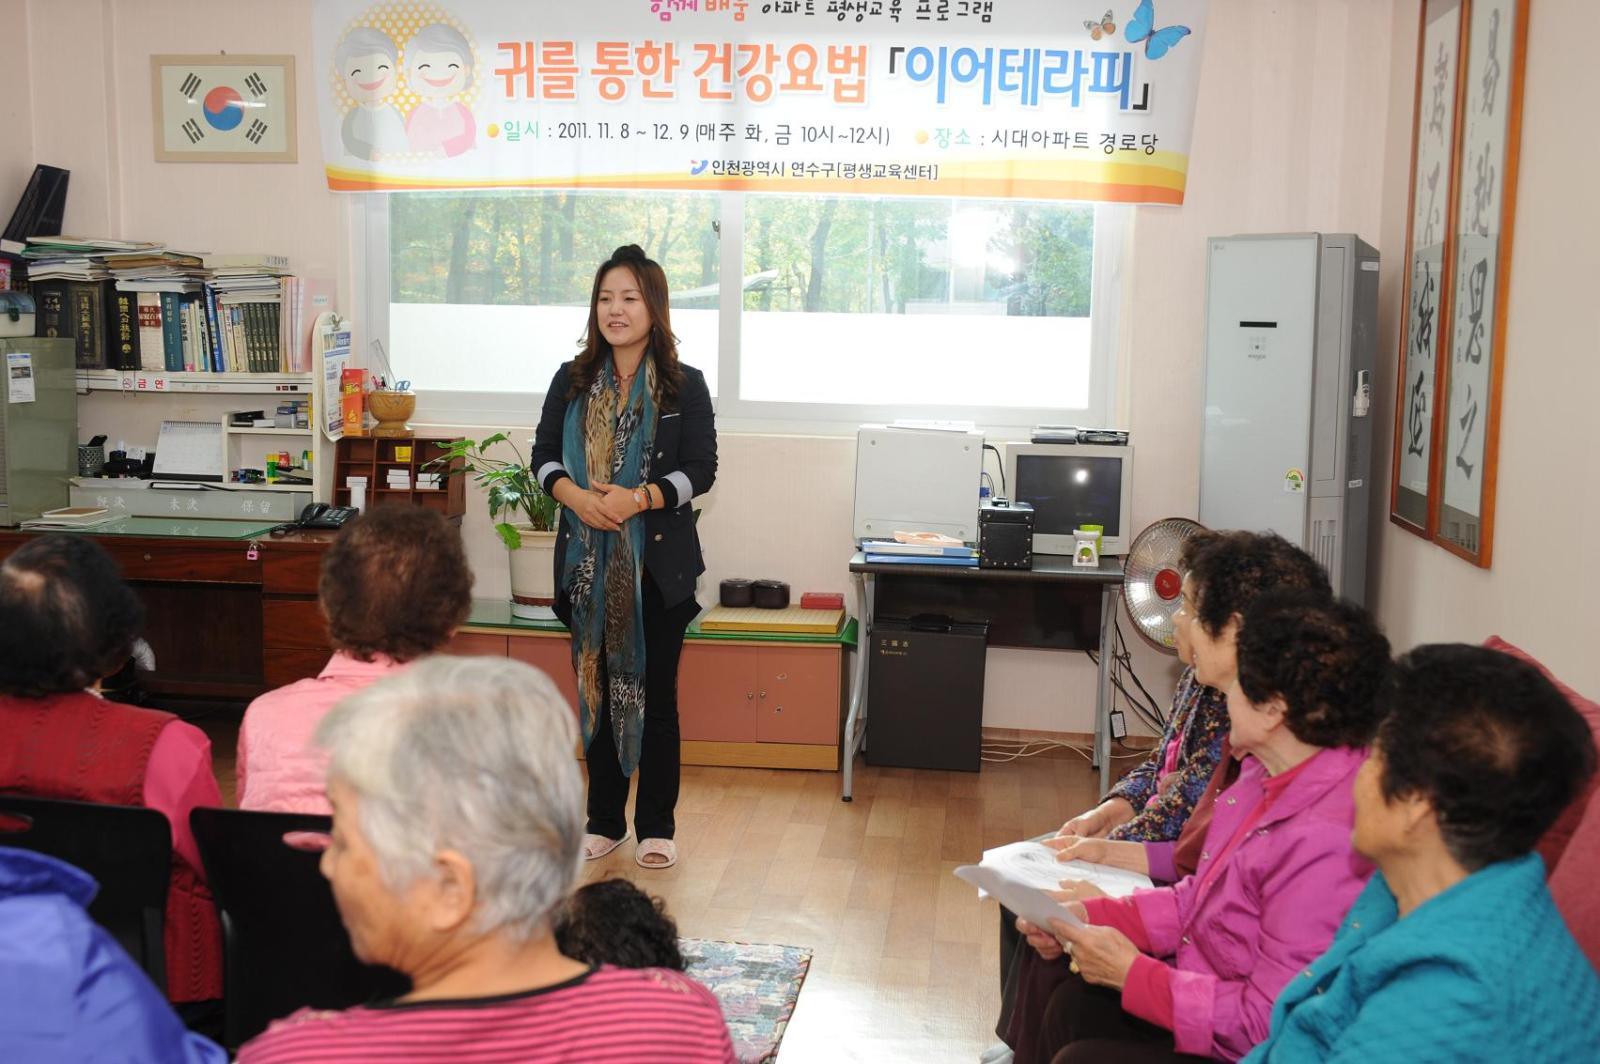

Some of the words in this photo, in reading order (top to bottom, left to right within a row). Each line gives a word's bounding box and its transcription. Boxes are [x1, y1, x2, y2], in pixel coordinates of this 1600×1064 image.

[762, 0, 815, 16] 아파트
[827, 0, 902, 23] 평생교육
[916, 0, 993, 23] 프로그램
[494, 40, 579, 99] 귀를
[591, 40, 680, 100] 통한
[693, 42, 867, 102] 건강요법
[504, 121, 540, 142] 일시
[558, 122, 591, 139] 2011.
[597, 122, 614, 139] 11.
[620, 122, 630, 140] 8
[652, 123, 673, 140] 12.
[679, 123, 690, 140] 9
[695, 122, 737, 143] (매주
[744, 123, 769, 144] 화,
[774, 124, 792, 145] 금
[800, 125, 890, 147] 10시~12시)
[933, 128, 972, 149] 장소
[991, 129, 1090, 149] 시대아파트
[1098, 131, 1159, 156] 경로당
[711, 160, 785, 177] 인천광역시
[791, 161, 939, 180] 연수구[평생교육센터]
